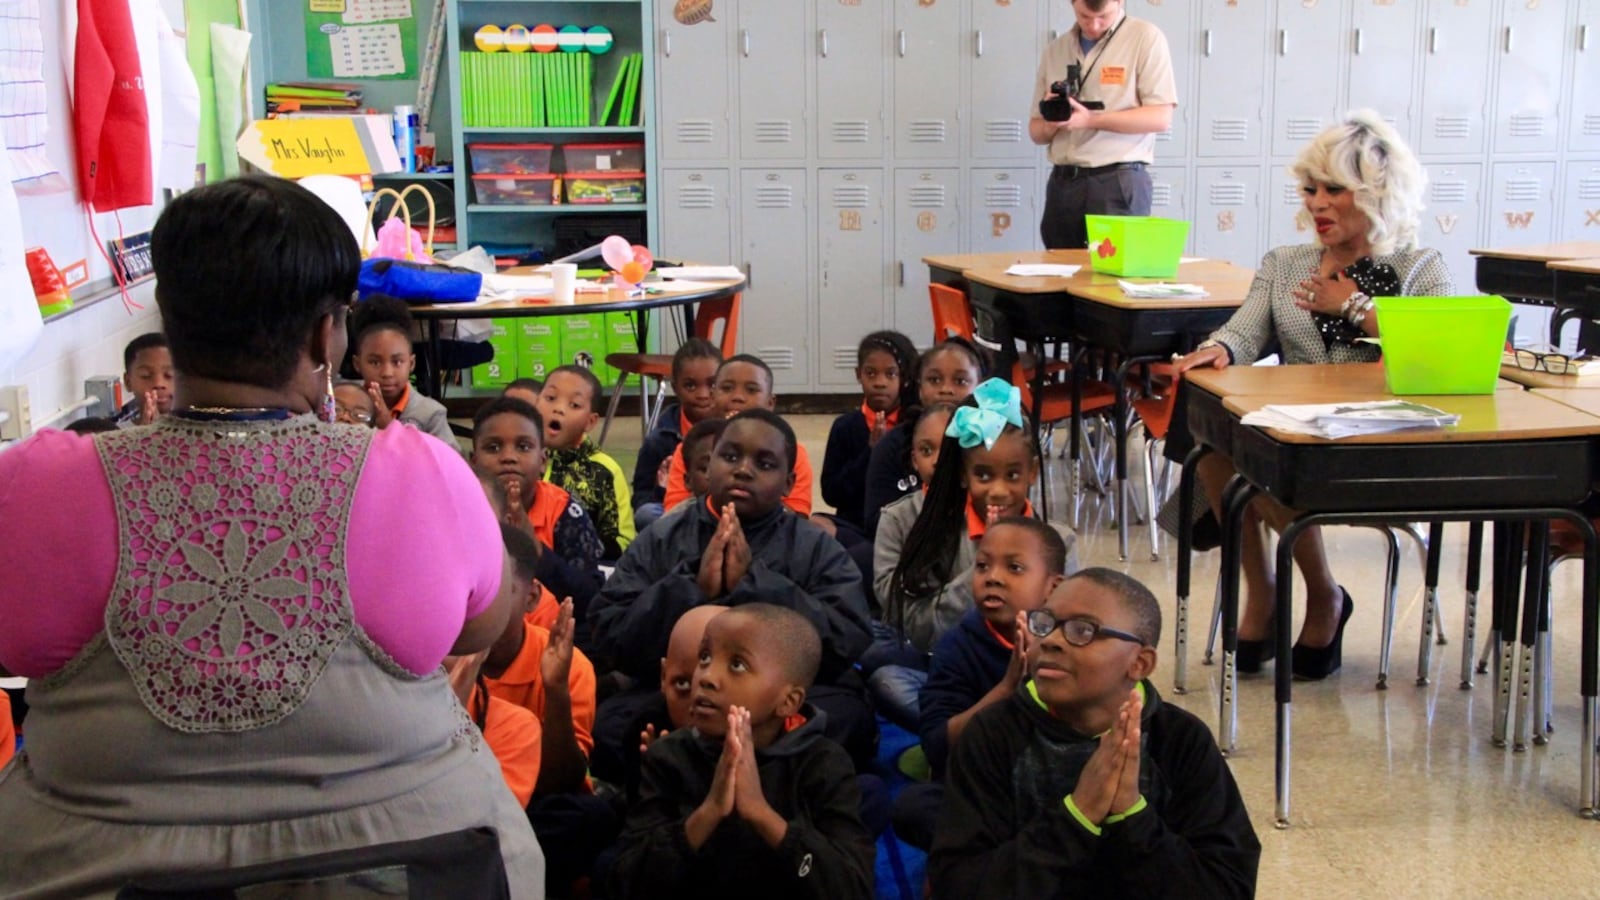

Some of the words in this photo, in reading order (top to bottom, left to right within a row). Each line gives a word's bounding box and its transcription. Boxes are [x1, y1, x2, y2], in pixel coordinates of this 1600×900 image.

[271, 138, 299, 159] Mrs
[296, 136, 345, 163] Vaughn
[489, 364, 500, 377] 2
[534, 364, 545, 377] 2
